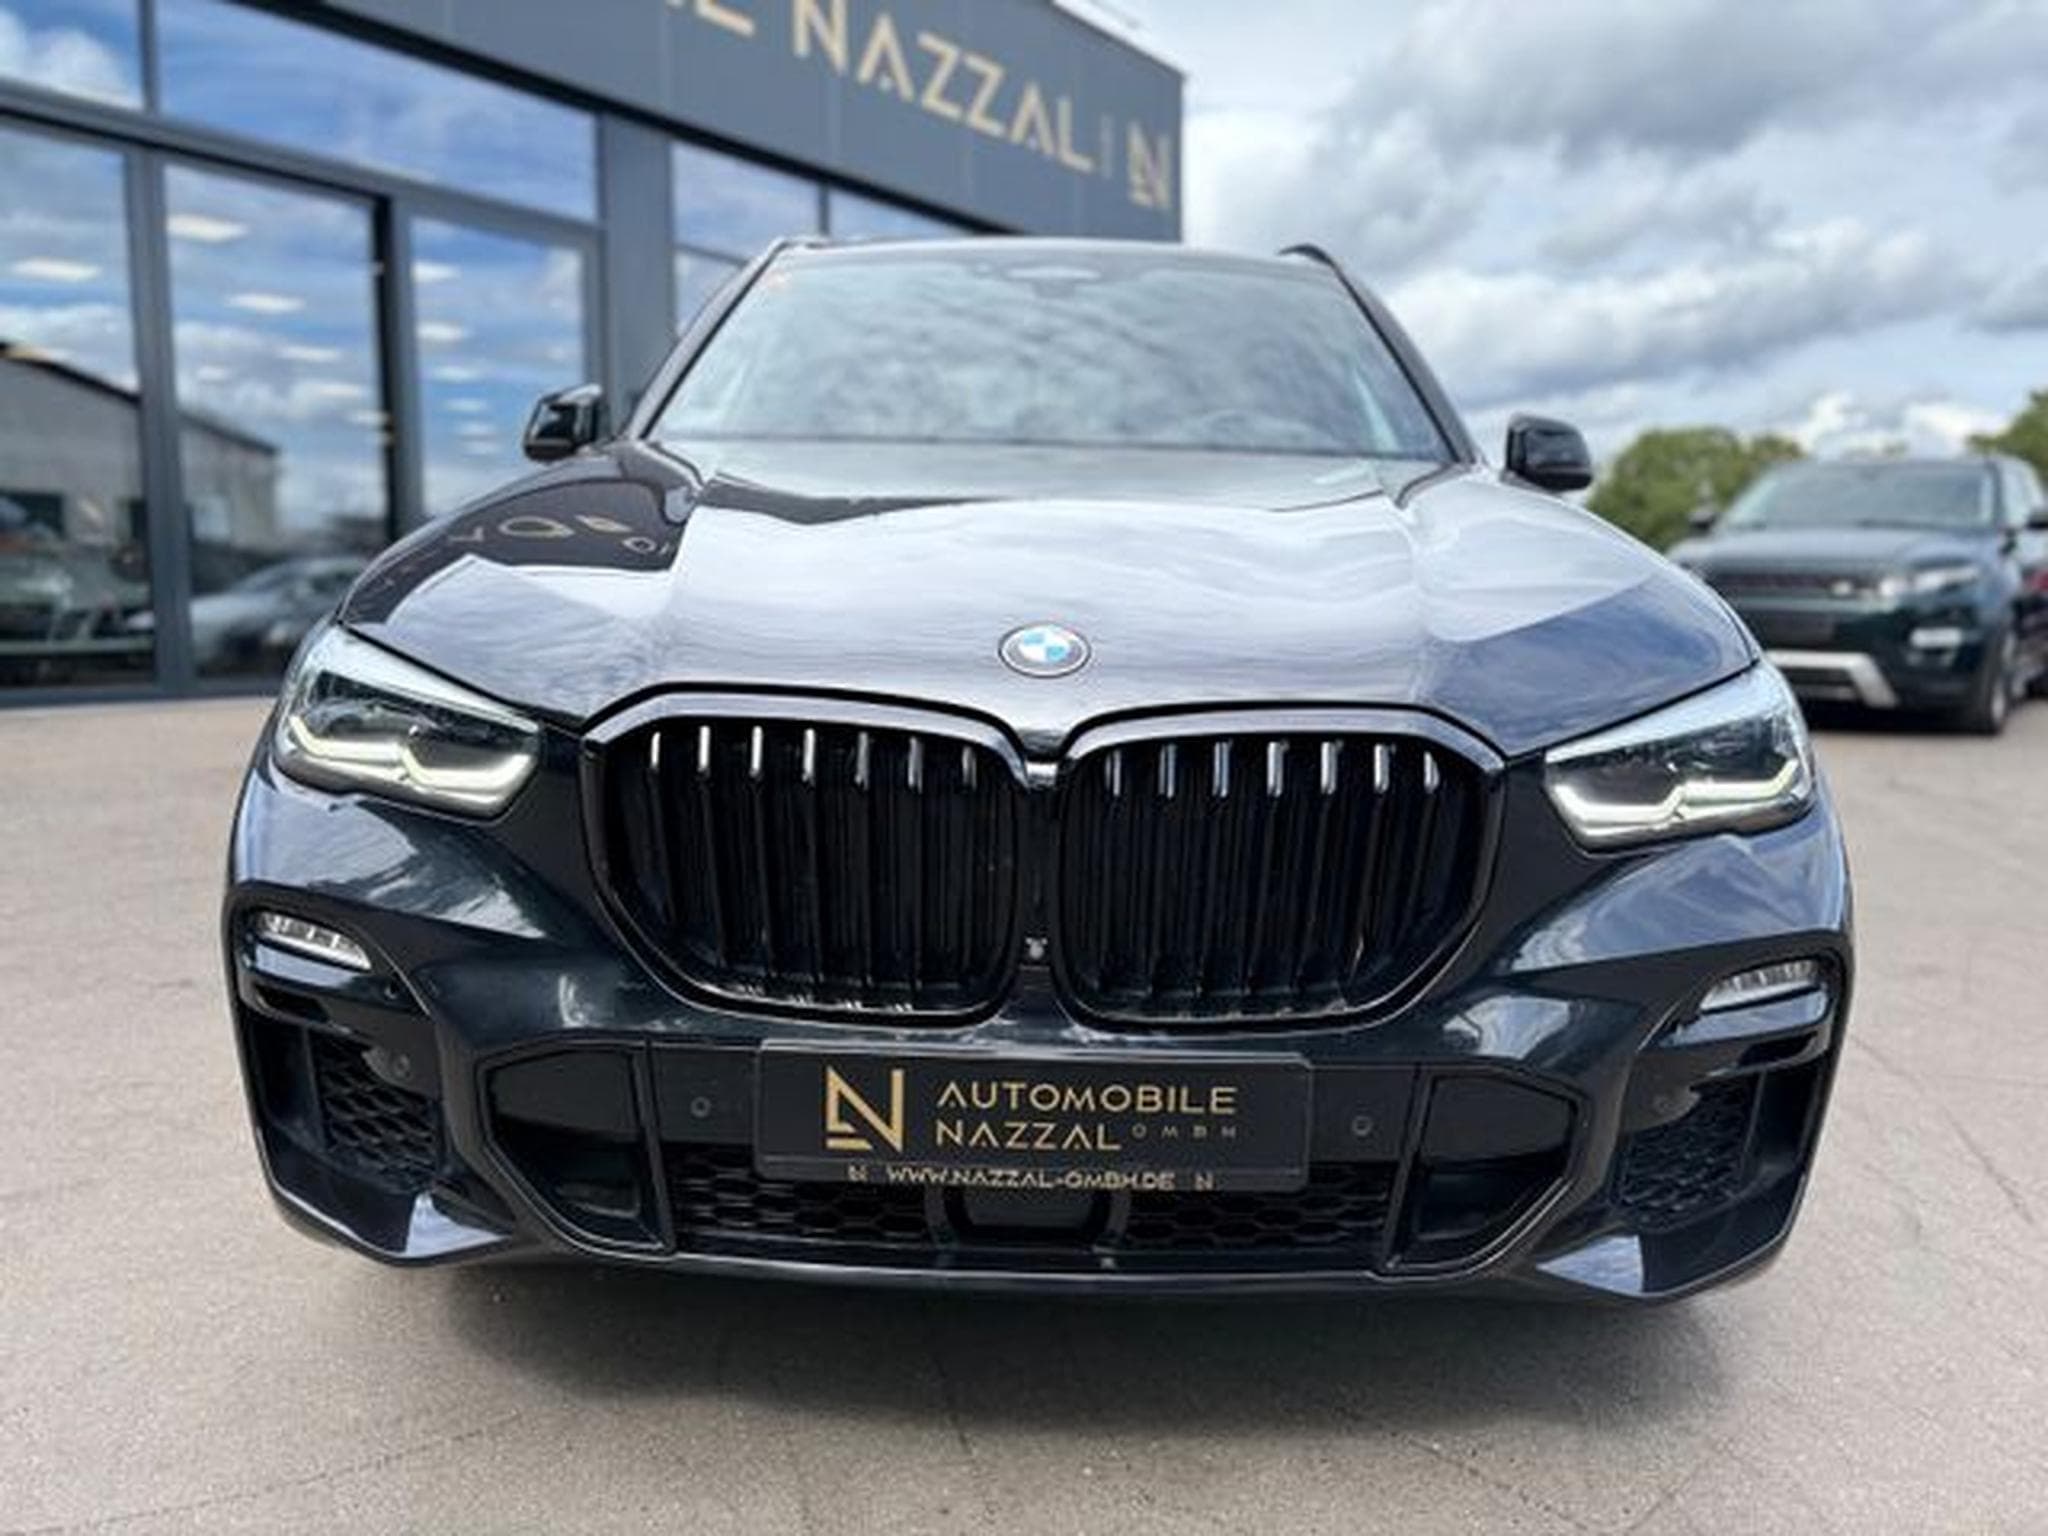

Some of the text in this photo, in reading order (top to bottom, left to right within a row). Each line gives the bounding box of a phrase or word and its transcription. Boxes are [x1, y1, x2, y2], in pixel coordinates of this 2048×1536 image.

[794, 0, 1094, 173] NAZZAL
[936, 1080, 1238, 1115] AUTOMOBILE
[935, 1118, 1123, 1151] NAZZAL
